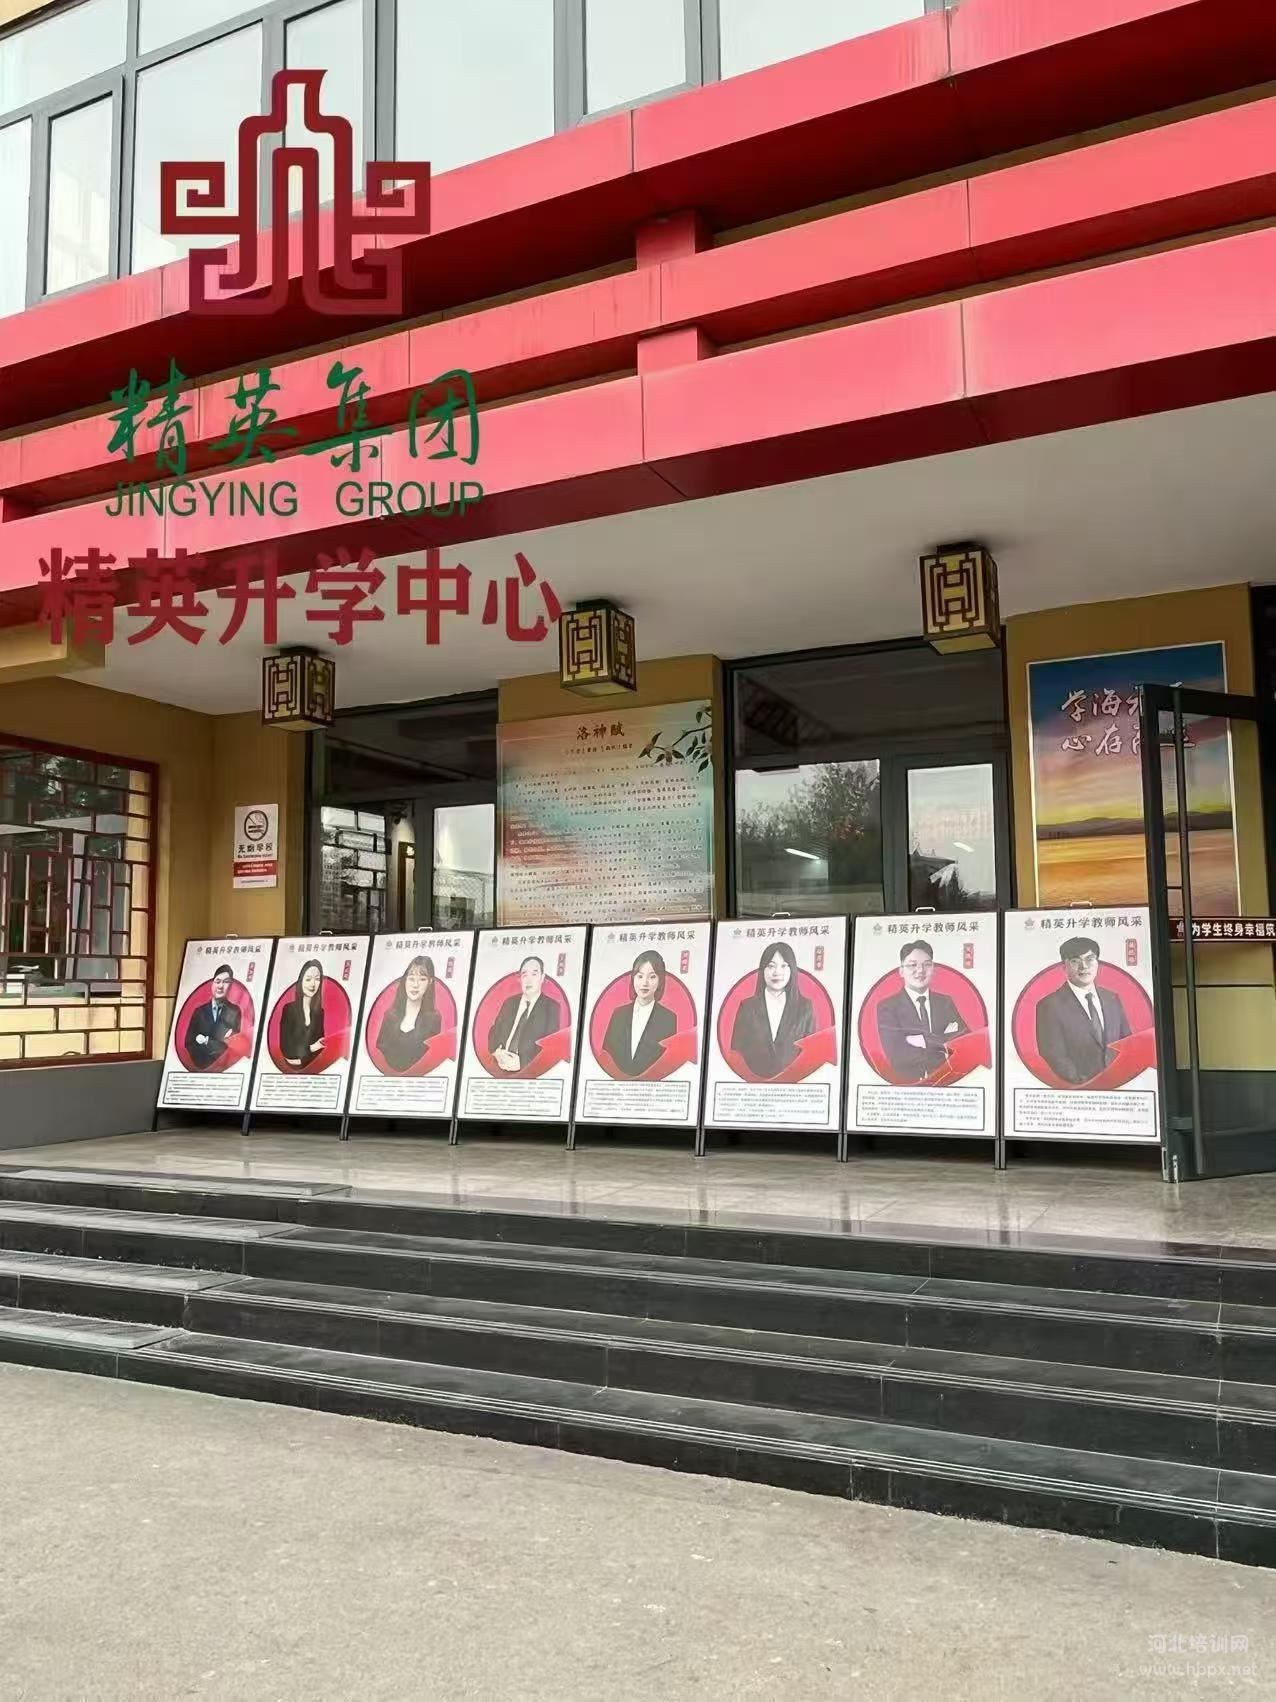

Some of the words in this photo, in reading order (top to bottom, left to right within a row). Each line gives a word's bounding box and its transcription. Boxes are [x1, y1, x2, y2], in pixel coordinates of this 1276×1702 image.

[887, 921, 980, 934] 精英升学教师风采
[1040, 916, 1143, 929] 精英升学教师风采
[619, 930, 696, 942] 精英升学教师风采
[746, 925, 830, 938] 精英升学教师风采
